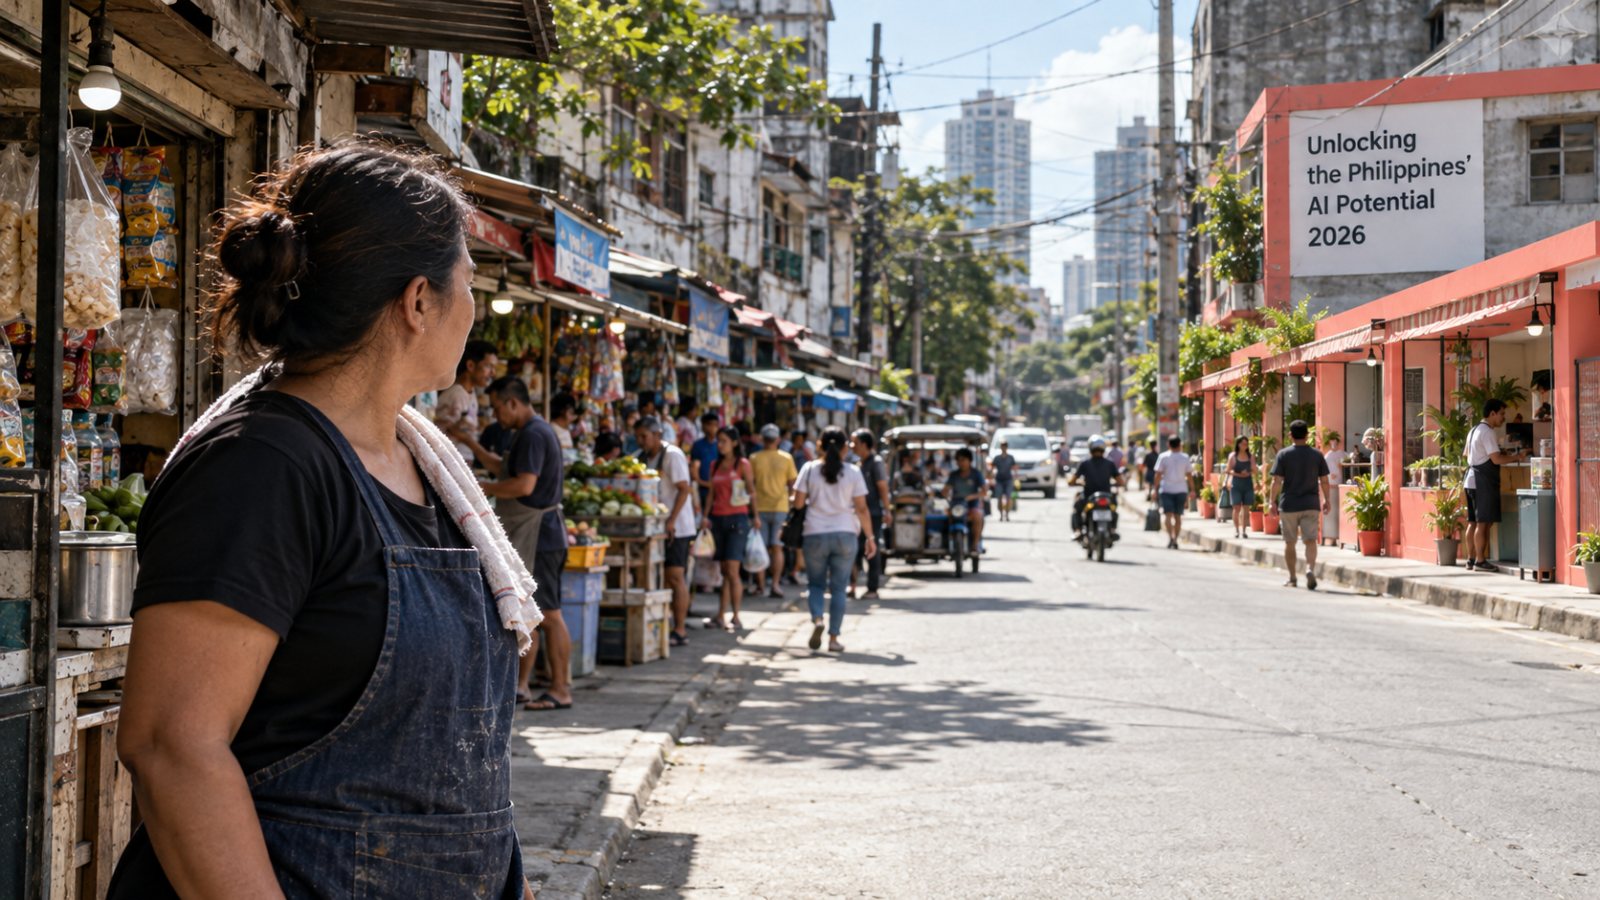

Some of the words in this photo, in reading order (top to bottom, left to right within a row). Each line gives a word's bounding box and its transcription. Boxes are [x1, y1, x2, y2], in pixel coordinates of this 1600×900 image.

[1307, 130, 1417, 154] Unlocking
[1306, 164, 1342, 185] the
[1307, 195, 1329, 216] AI
[1336, 187, 1435, 214] Potential
[1308, 224, 1366, 248] 2026
